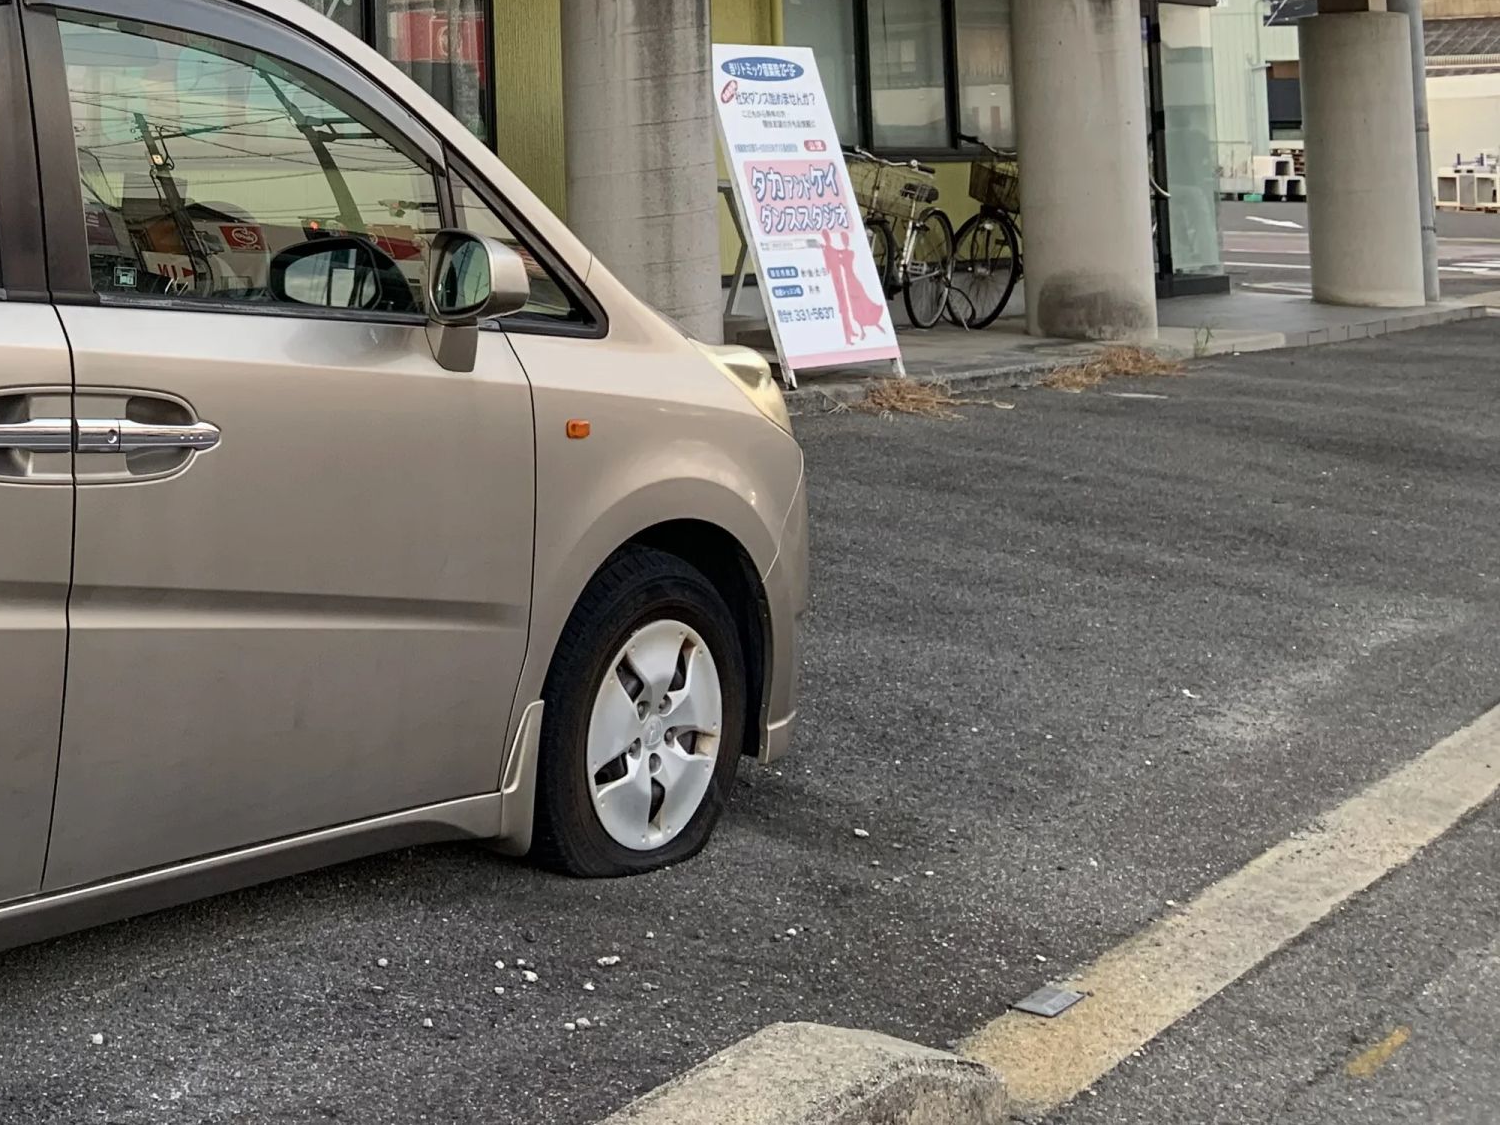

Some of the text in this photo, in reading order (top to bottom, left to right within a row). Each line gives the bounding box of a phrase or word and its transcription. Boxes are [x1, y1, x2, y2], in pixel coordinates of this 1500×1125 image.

[761, 203, 850, 234] ダンススタジオ
